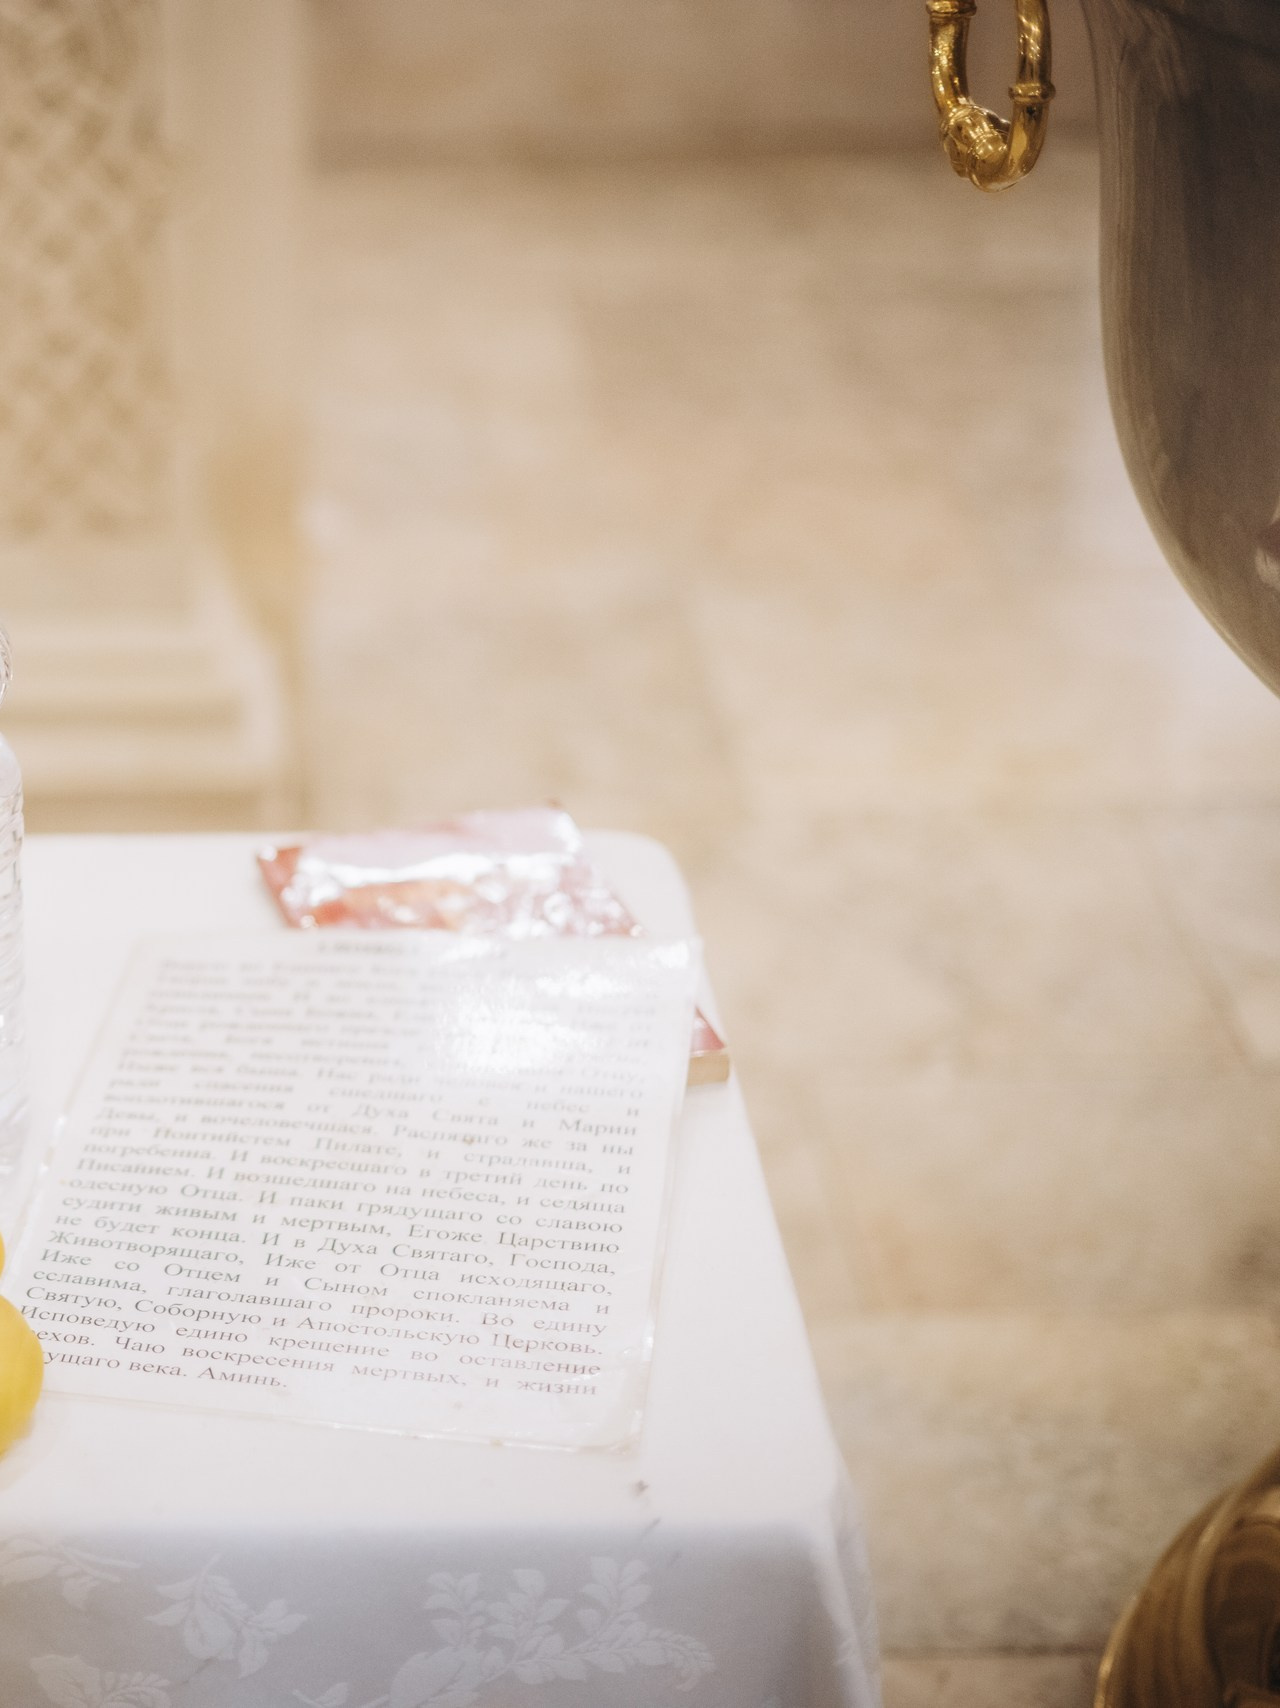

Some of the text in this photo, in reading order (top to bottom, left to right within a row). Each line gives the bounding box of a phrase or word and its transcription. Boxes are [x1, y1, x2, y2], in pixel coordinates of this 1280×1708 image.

[95, 1107, 160, 1123] Девы,
[173, 1113, 187, 1122] и
[199, 1114, 376, 1134] вочеловечшася.
[521, 1137, 552, 1149] же
[570, 1141, 587, 1152] за
[601, 1143, 633, 1155] ны
[306, 1103, 330, 1113] от
[351, 1103, 409, 1120] Духа
[431, 1109, 498, 1126] Свята
[521, 1119, 534, 1128] и
[559, 1118, 636, 1136] Марии
[83, 1143, 628, 1193] погребенна. И воскресшаго в третий день по
[89, 1126, 630, 1174] при Понтийстем Пилате, и страдавша, и
[68, 1178, 622, 1232] одесную Отца. И паки грядущаго со славою
[206, 1166, 225, 1179] И
[233, 1171, 376, 1192] возшедшаго
[385, 1184, 411, 1196] на
[421, 1186, 505, 1205] небеса,
[516, 1196, 529, 1205] и
[539, 1198, 624, 1213] седяща
[55, 1215, 615, 1275] не будет конца. И в Духа Святаго, Господа,
[61, 1197, 619, 1253] судити живым и мертвым, Егоже Царствию
[40, 1248, 608, 1314] Иже со Отцем и Сыном спокланяема и
[44, 1230, 612, 1296] Животворящаго, Иже от Отца исходящаго,
[25, 1286, 602, 1354] Святую, Соборную и Апостольскую Церковь.
[32, 1270, 606, 1337] сславима, глаголавшаго пророки. Во едину
[20, 1305, 600, 1375] Исповедую едино крещение во оставление
[31, 1330, 596, 1395] ехов. Чаю воскресения мертвых, и жизни
[128, 1361, 186, 1376] века.
[197, 1366, 286, 1387] Аминь.
